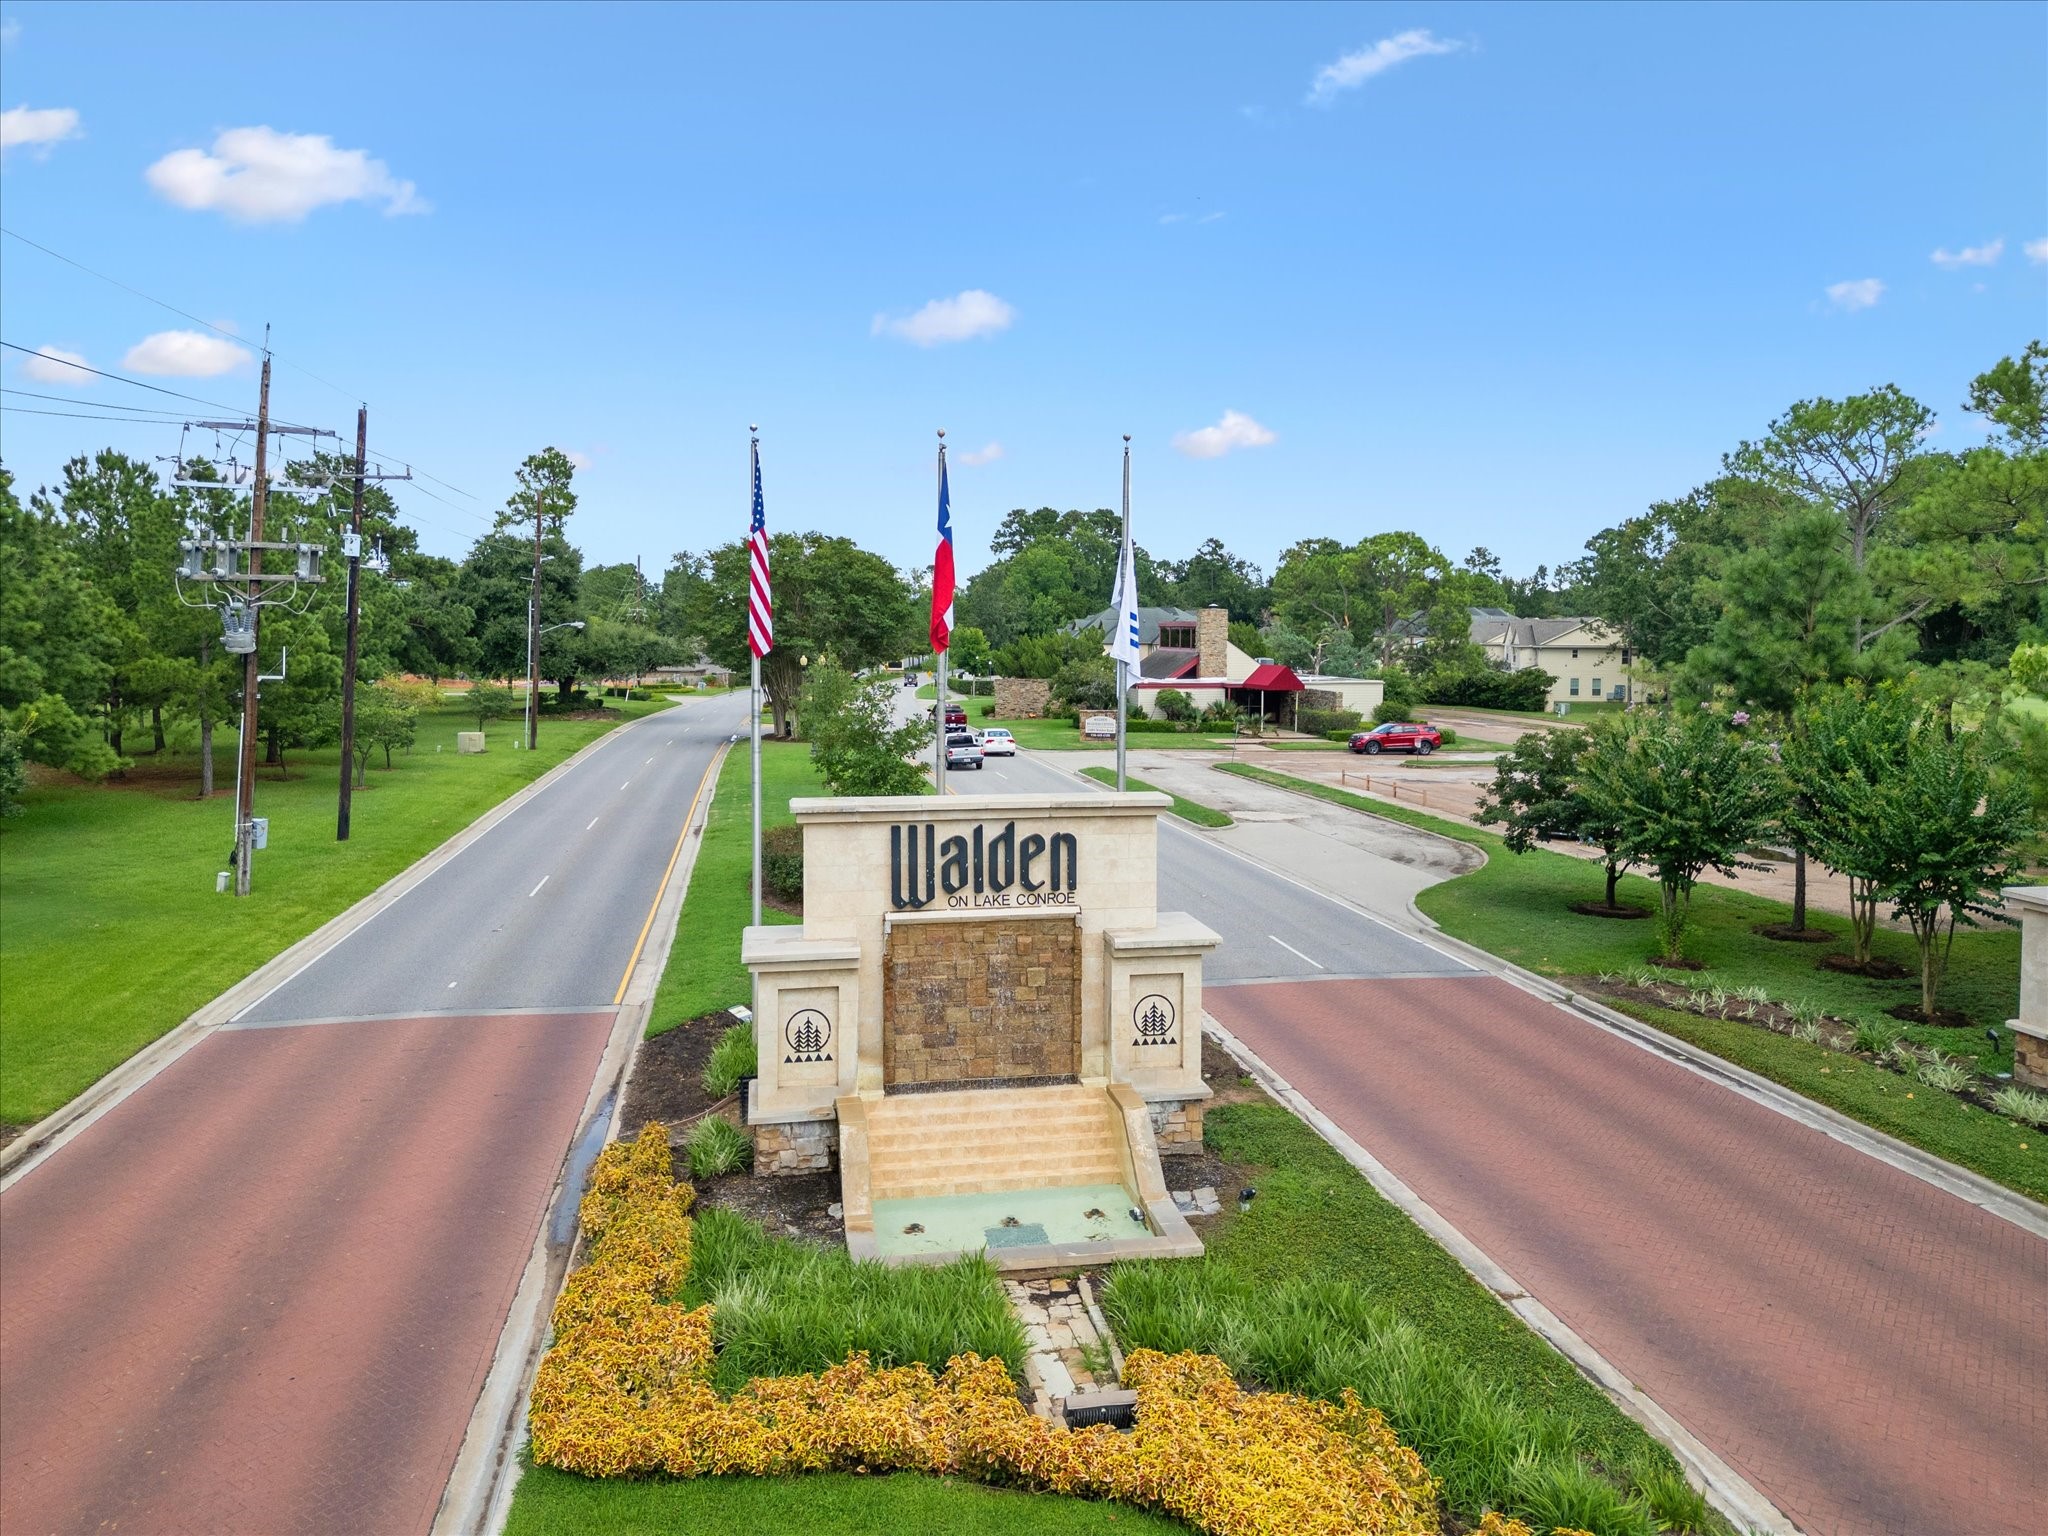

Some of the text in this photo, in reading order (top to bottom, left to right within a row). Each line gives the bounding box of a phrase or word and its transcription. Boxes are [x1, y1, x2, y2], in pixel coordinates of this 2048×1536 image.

[890, 821, 1077, 909] Walden
[947, 892, 1076, 908] ON LAKE CONROE
